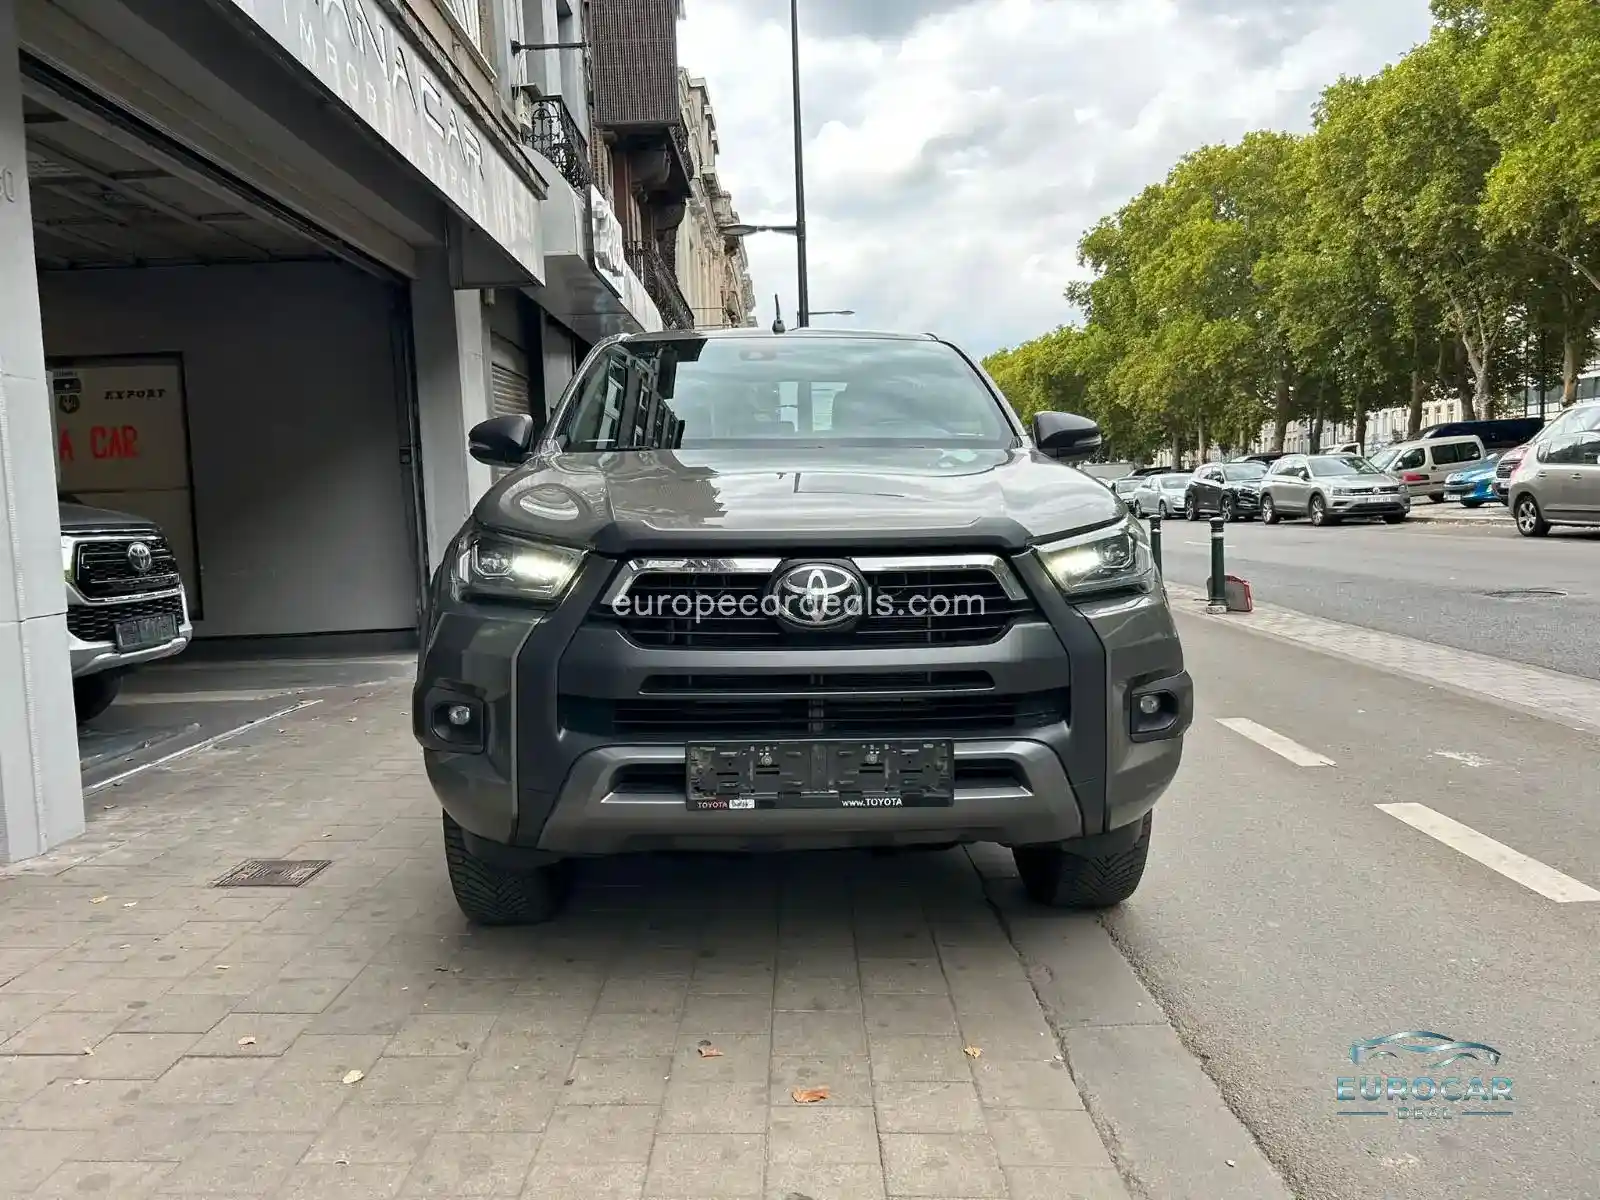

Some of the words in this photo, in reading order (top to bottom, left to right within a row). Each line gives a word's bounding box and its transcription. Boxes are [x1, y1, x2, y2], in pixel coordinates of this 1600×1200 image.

[104, 388, 166, 400] EXPORT
[90, 424, 138, 459] CAR
[697, 801, 728, 809] TOYOTA
